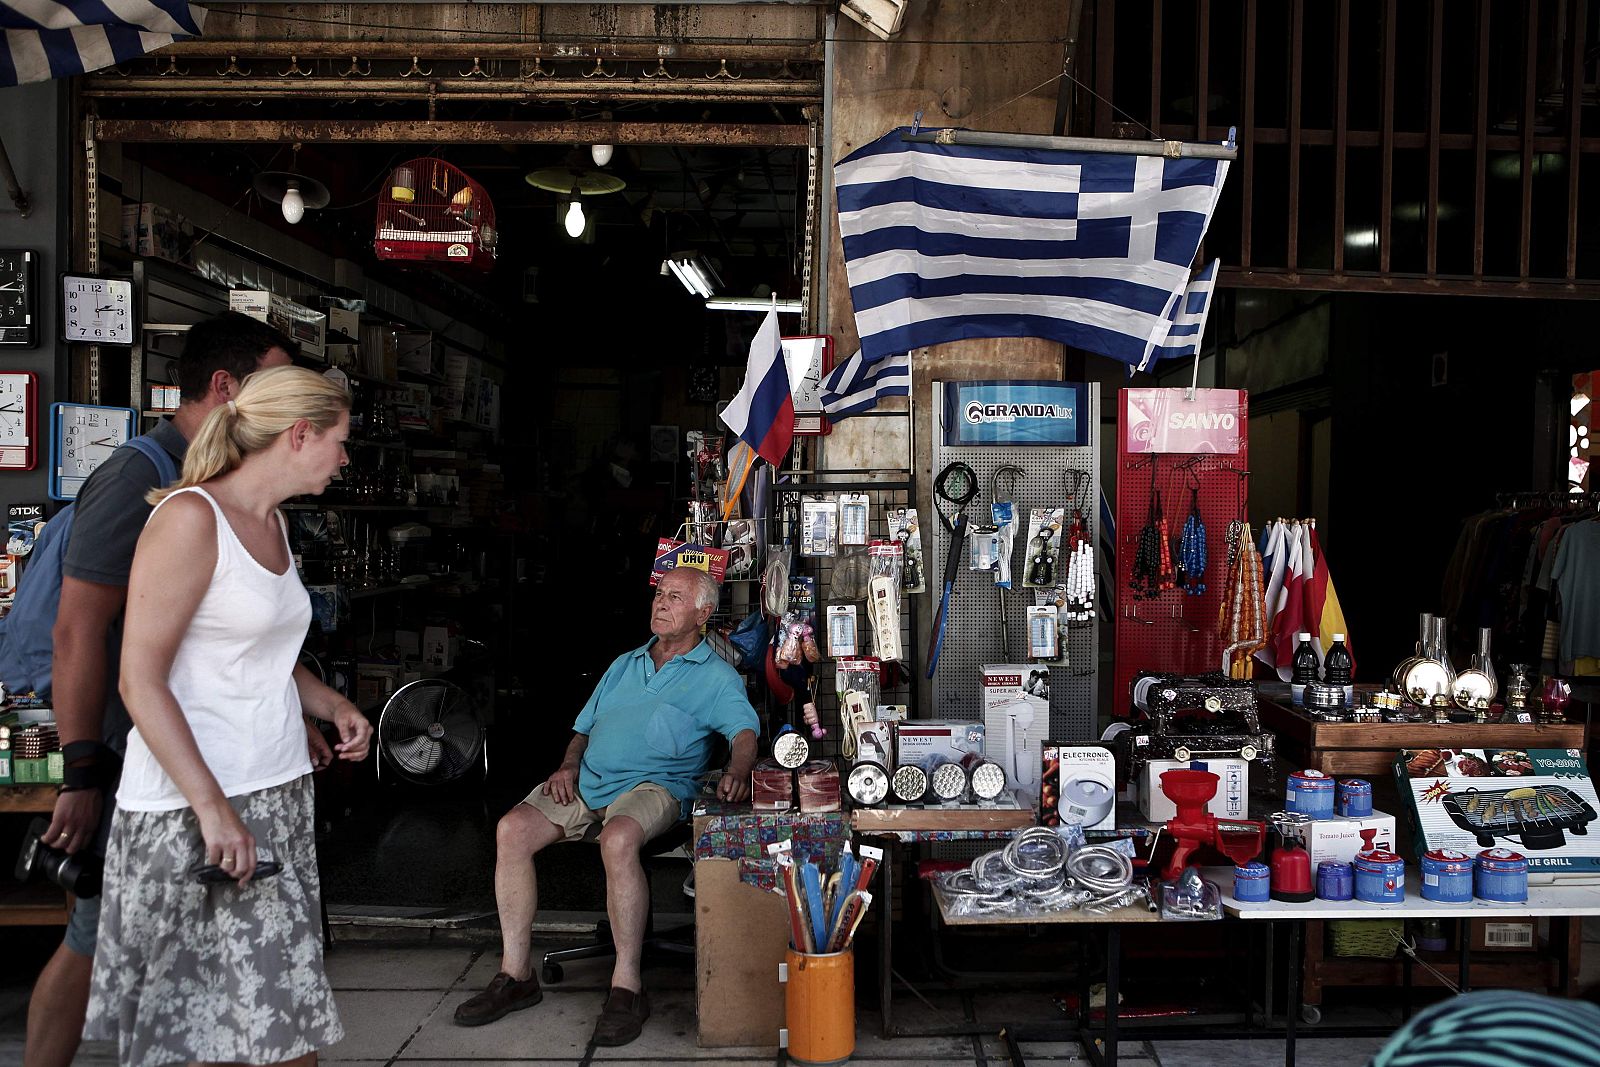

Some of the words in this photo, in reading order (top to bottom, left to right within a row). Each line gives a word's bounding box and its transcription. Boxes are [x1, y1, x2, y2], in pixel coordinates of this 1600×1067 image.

[9, 262, 13, 271] 1
[16, 272, 23, 281] 2
[78, 284, 85, 292] 11
[91, 284, 101, 292] 12
[16, 296, 23, 306] 4
[9, 307, 15, 316] 5
[117, 308, 124, 316] 3
[9, 384, 13, 392] 1
[15, 418, 22, 426] 4
[77, 417, 86, 425] 11
[89, 414, 99, 422] 12
[1169, 413, 1235, 430] SANYO
[8, 428, 14, 436] 5
[69, 426, 79, 435] 10
[112, 429, 118, 437] 2
[66, 437, 72, 446] 9
[68, 449, 75, 458] 8
[16, 506, 40, 515] TDK
[683, 555, 704, 563] UHU
[1544, 858, 1572, 866] GRILL
